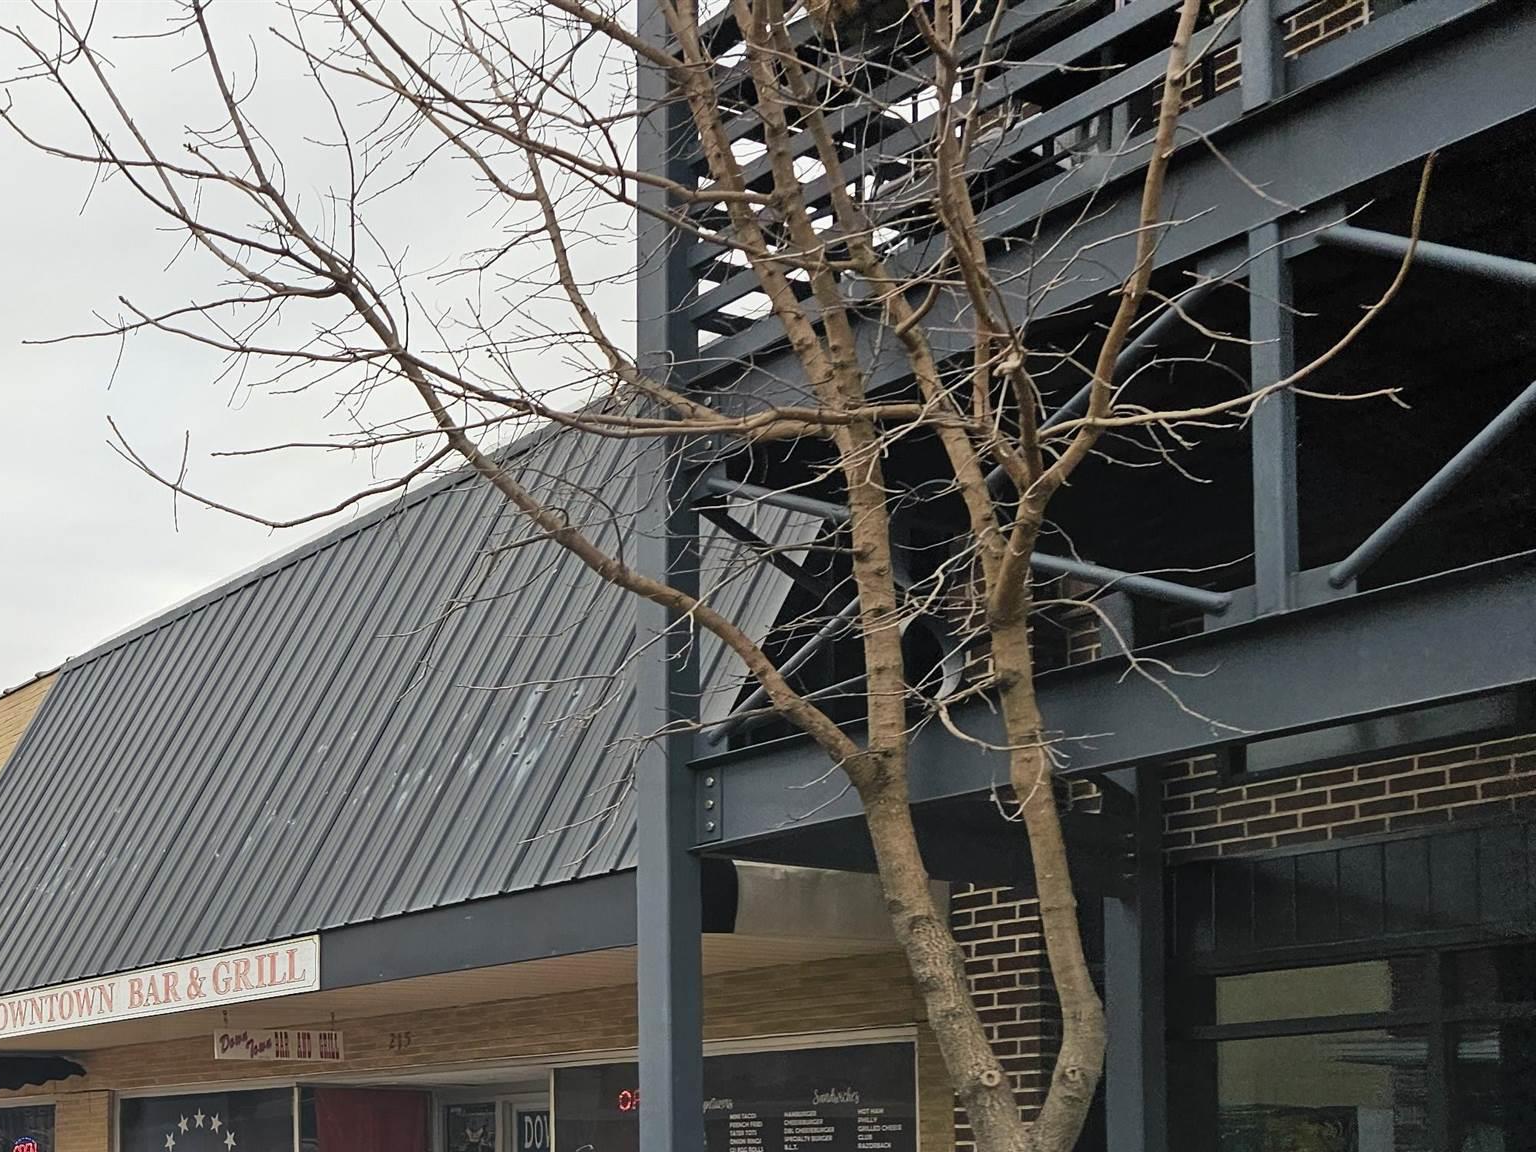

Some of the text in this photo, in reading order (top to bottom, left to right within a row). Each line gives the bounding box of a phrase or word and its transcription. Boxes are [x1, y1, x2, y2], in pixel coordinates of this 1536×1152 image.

[128, 971, 181, 1009] BAR
[187, 966, 207, 1000] &
[213, 948, 306, 995] GRILL
